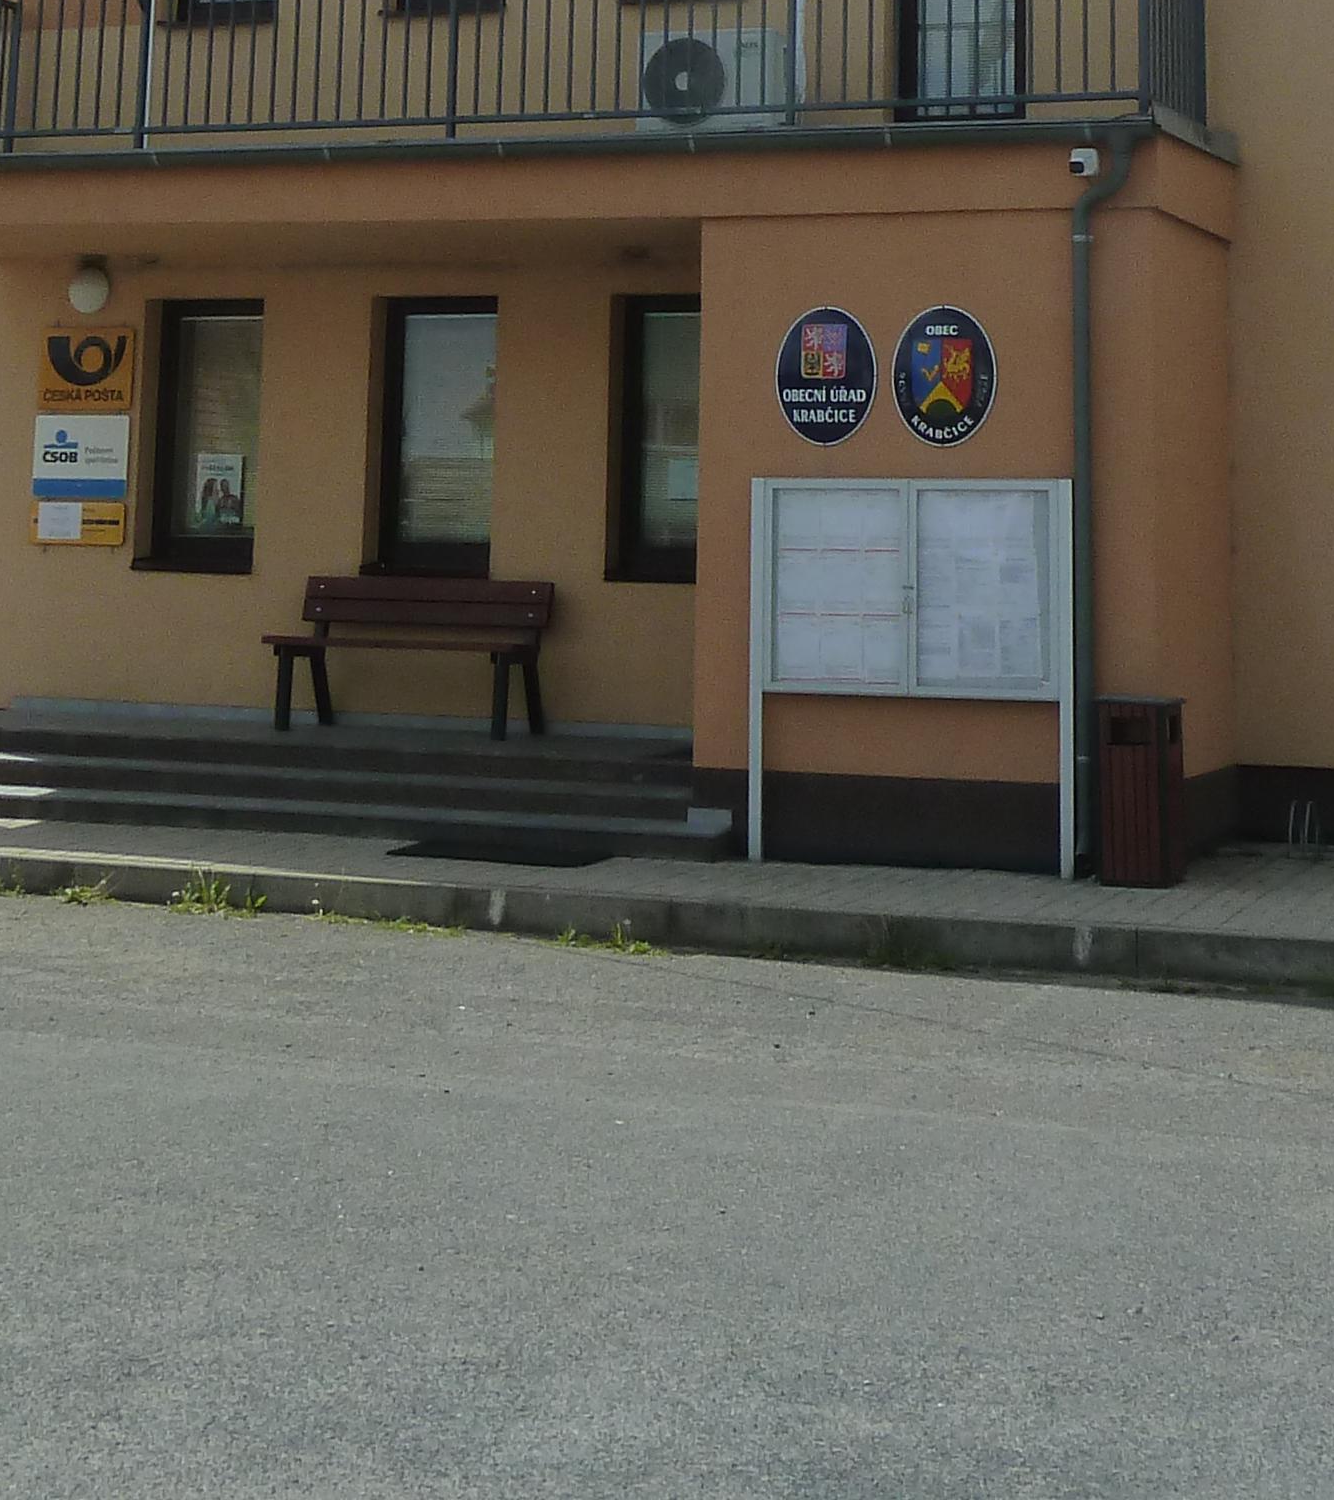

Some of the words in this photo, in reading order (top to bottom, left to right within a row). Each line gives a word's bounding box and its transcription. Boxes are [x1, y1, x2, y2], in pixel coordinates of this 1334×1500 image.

[925, 324, 959, 336] OBEC
[43, 387, 82, 402] ČESKÁ
[84, 387, 124, 402] POŠTA
[782, 385, 826, 402] OBECNÍ
[830, 385, 866, 402] ÚŘAD
[792, 406, 856, 423] KRABČICE
[910, 414, 975, 439] KRABČICE
